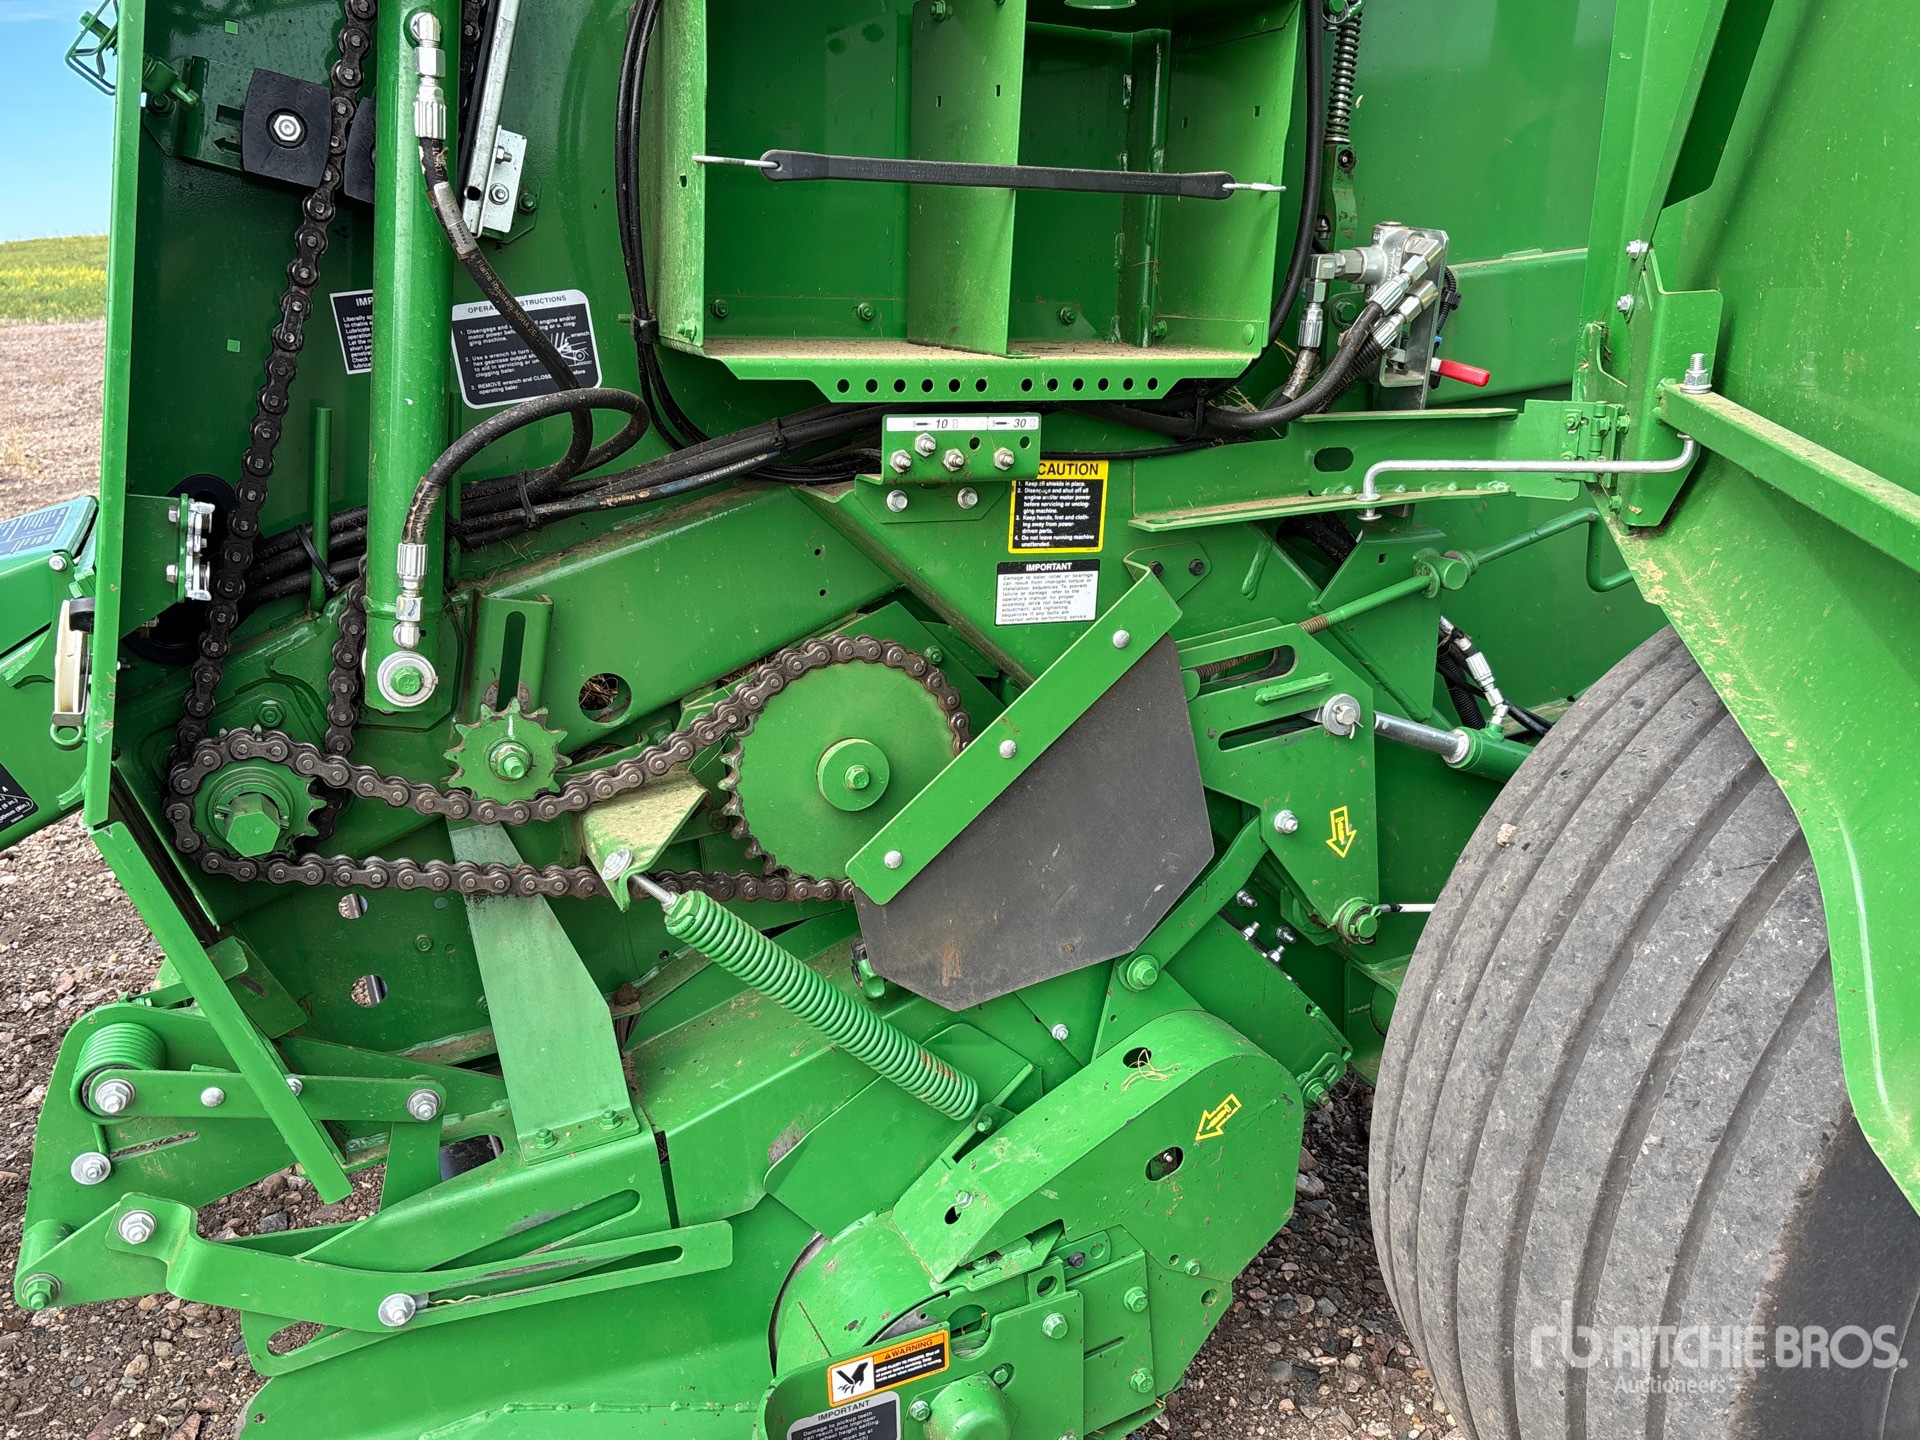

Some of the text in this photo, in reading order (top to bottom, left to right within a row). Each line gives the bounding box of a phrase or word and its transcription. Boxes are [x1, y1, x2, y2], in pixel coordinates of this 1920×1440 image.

[936, 419, 948, 428] 10
[1014, 419, 1026, 428] 30
[1039, 463, 1098, 475] CAUTION
[1026, 562, 1072, 571] IMPORTANT
[891, 1339, 933, 1356] WARNING
[818, 1400, 870, 1421] IMPORTANT
[803, 1426, 827, 1437] Damage
[836, 1417, 857, 1427] pickup
